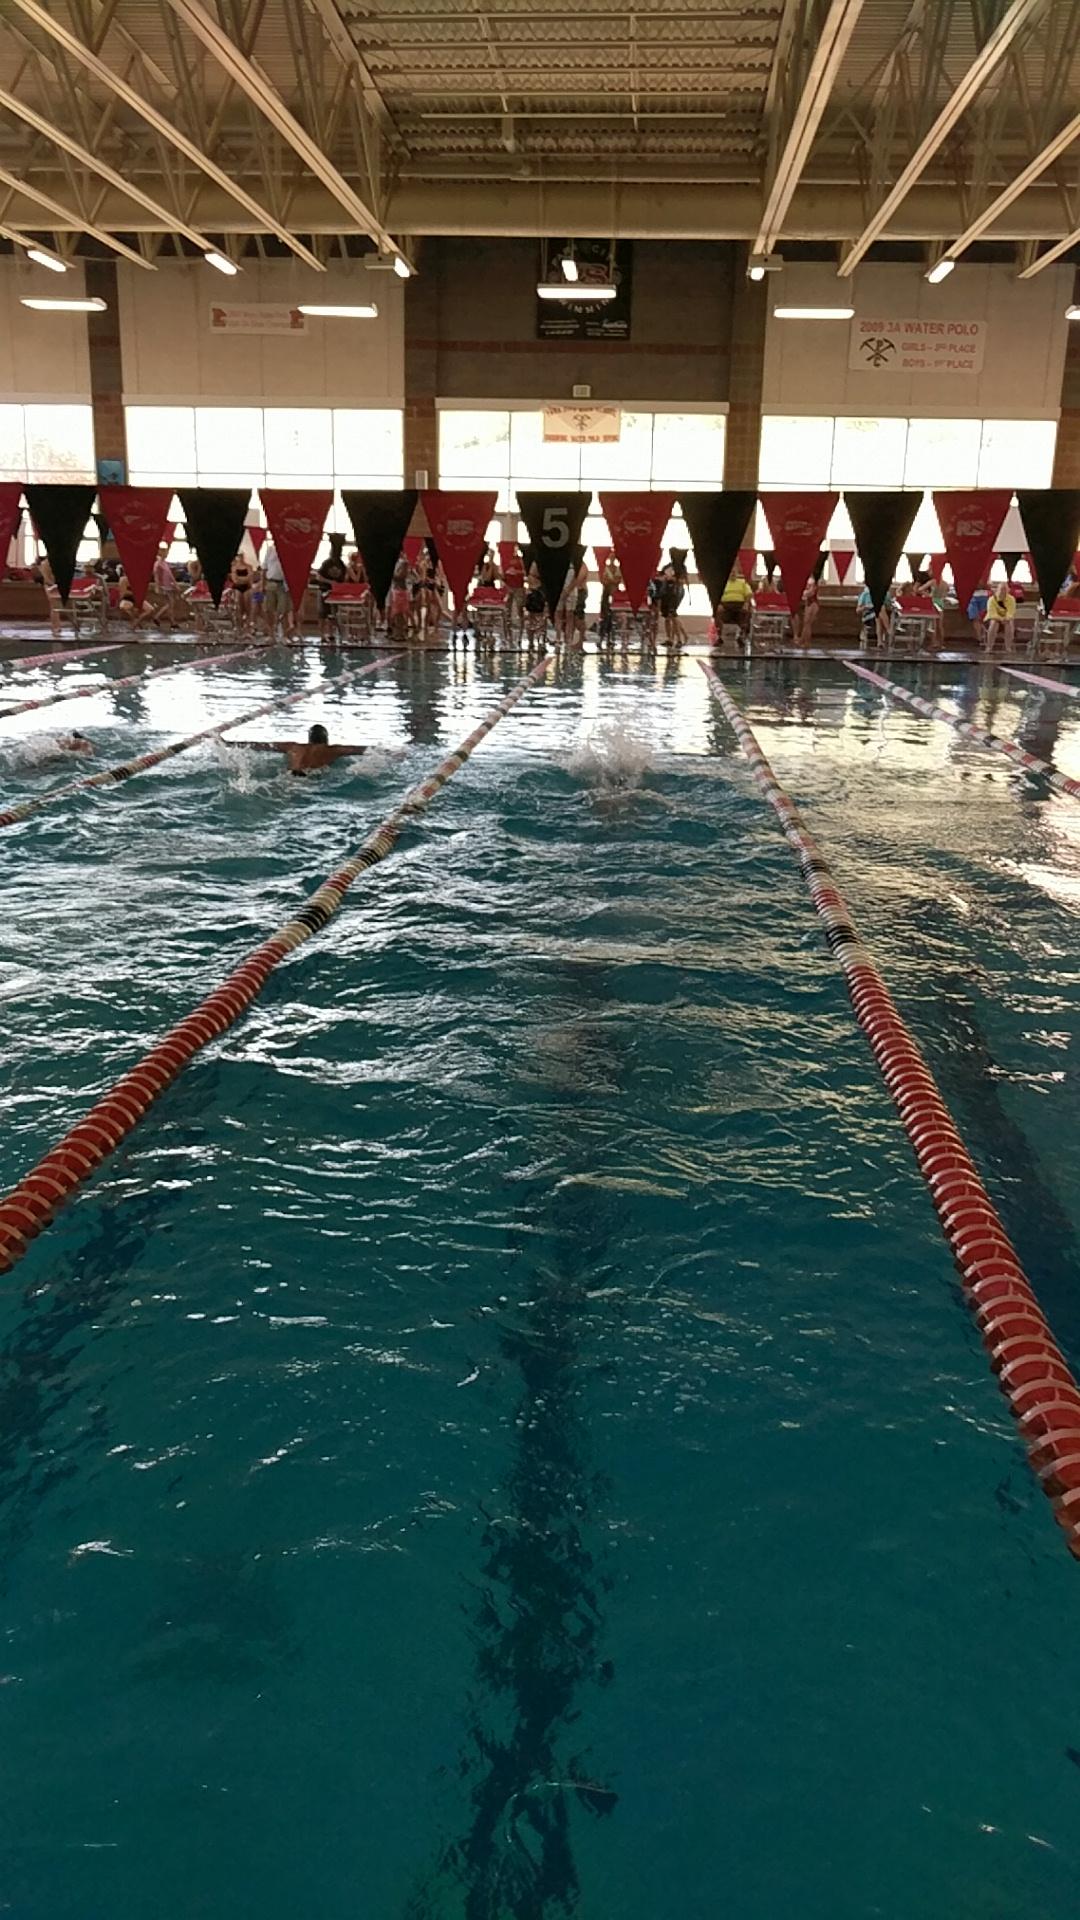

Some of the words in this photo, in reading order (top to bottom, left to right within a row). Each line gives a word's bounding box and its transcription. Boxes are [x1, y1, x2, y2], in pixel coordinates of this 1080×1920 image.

[904, 323, 945, 335] WATER
[947, 323, 979, 336] POLO
[948, 343, 976, 354] PLACE
[947, 359, 974, 369] PLACE
[542, 507, 569, 548] 5
